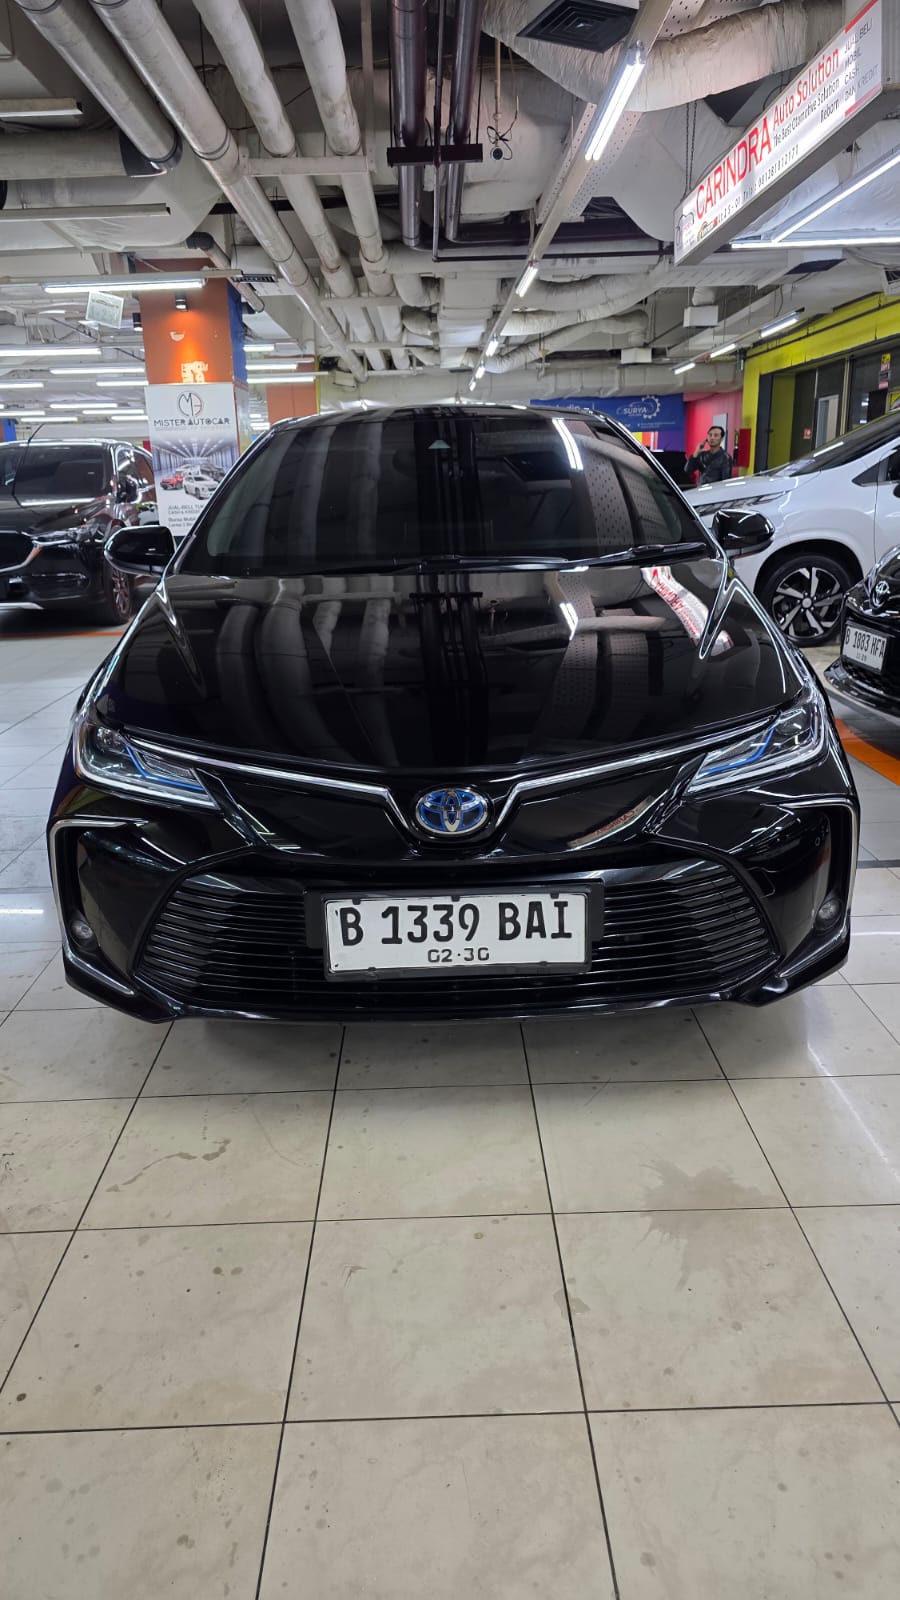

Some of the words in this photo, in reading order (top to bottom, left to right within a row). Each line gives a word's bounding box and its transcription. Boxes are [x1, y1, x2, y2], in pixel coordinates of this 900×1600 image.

[859, 18, 873, 39] BELI
[844, 64, 860, 85] CASH
[773, 94, 794, 131] Auto
[797, 48, 839, 107] Solution
[818, 77, 840, 106] Solution
[696, 116, 772, 220] CARINDRA
[154, 418, 186, 427] MISTER
[188, 417, 230, 426] AUTOCAR
[623, 407, 647, 415] SURYA
[845, 628, 851, 645] B
[853, 630, 871, 652] 1883
[340, 906, 364, 946] B
[381, 903, 480, 944] 1339
[498, 900, 572, 940] BAI
